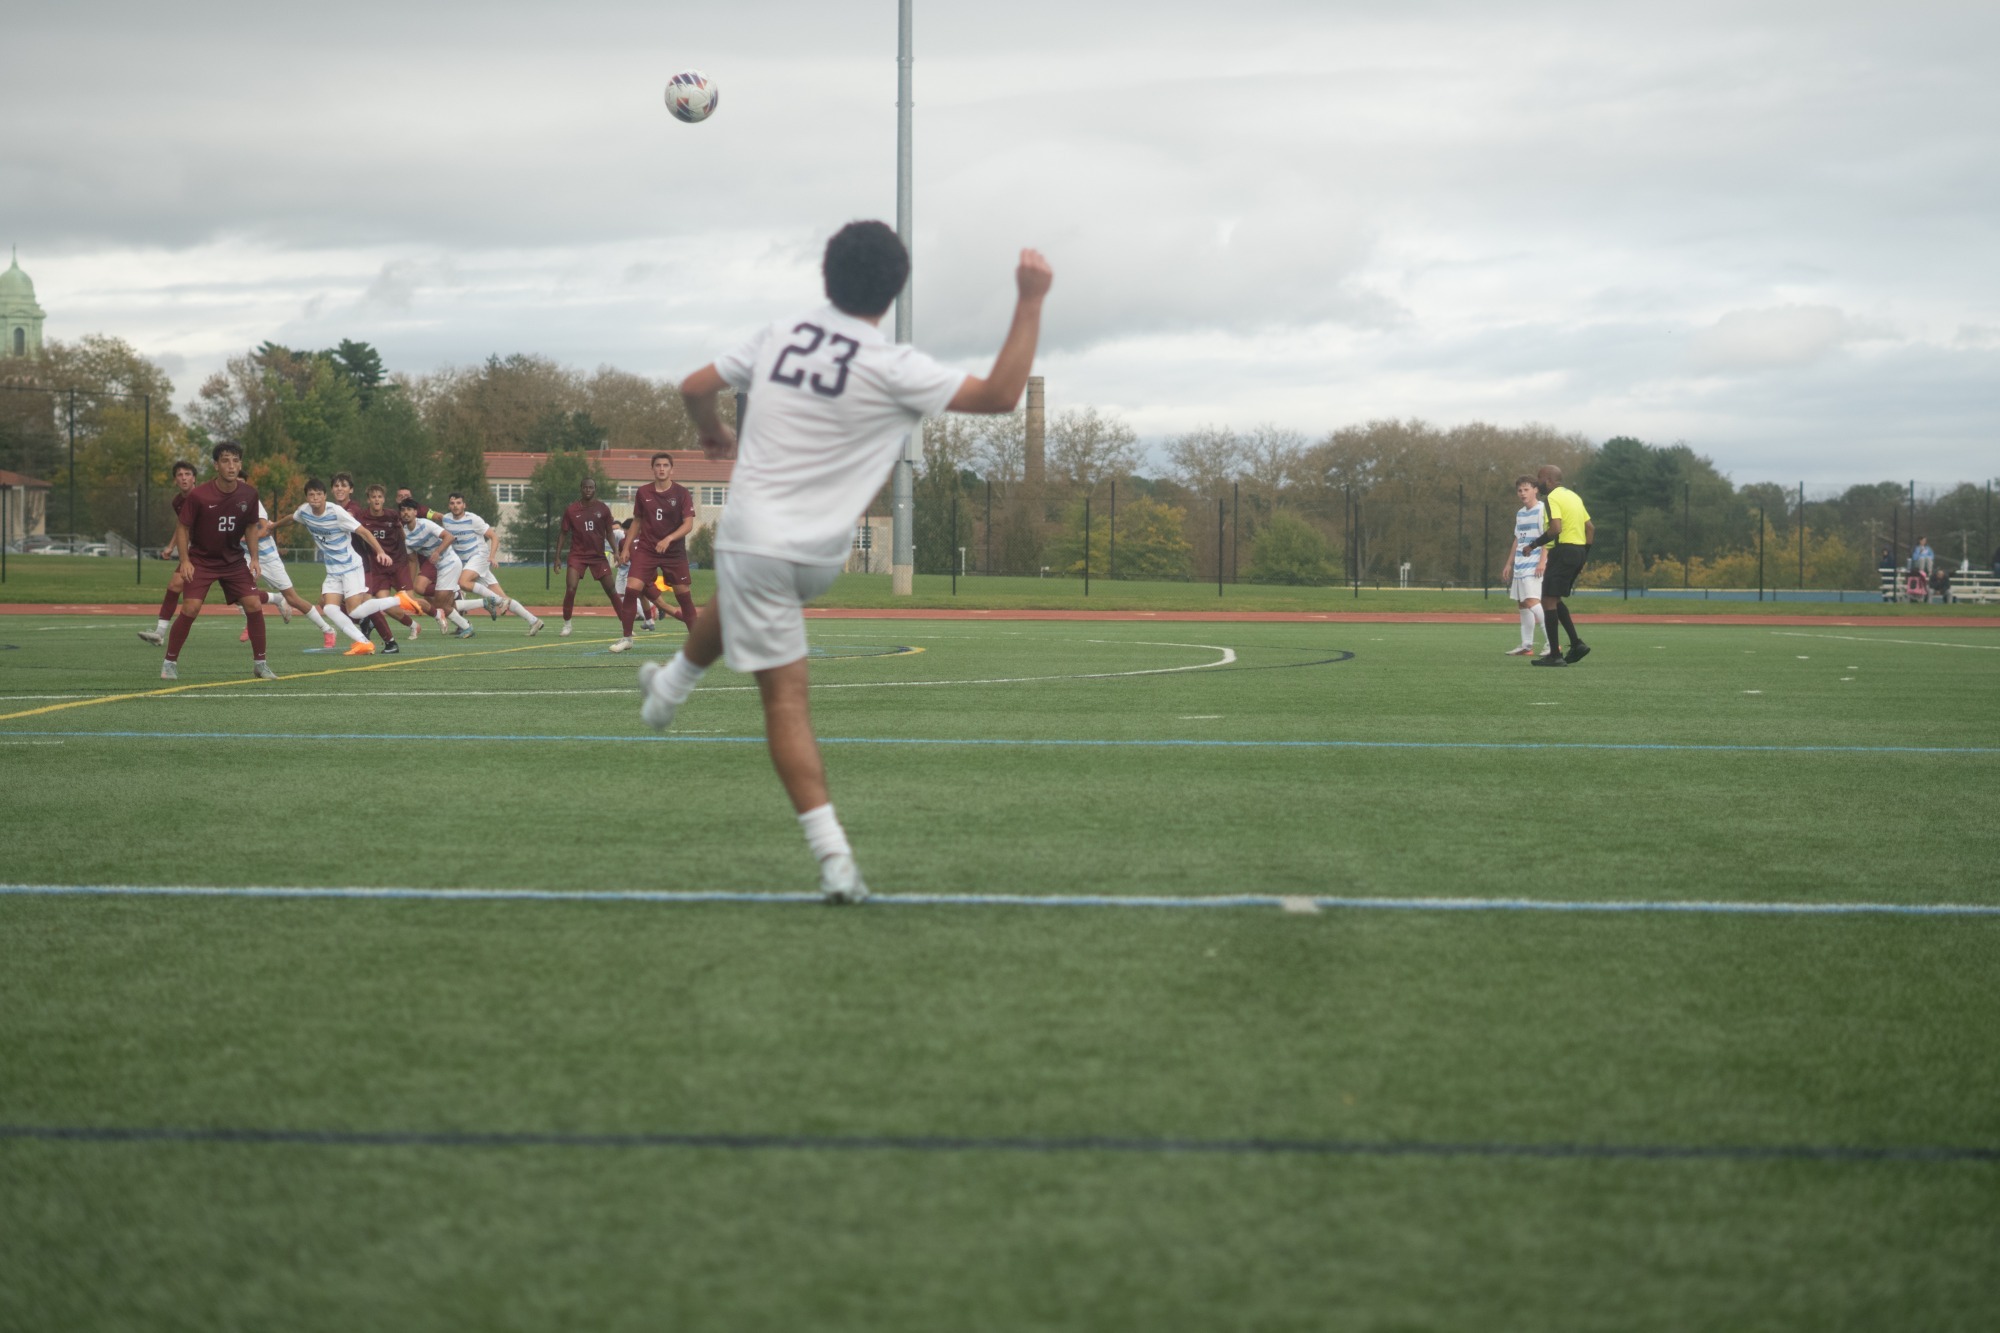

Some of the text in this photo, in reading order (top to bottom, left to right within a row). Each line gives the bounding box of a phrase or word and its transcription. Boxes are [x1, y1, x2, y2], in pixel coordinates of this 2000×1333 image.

[769, 322, 860, 398] 23
[656, 508, 663, 521] 6
[218, 516, 236, 532] 25
[584, 520, 594, 531] 19
[373, 530, 386, 539] 29
